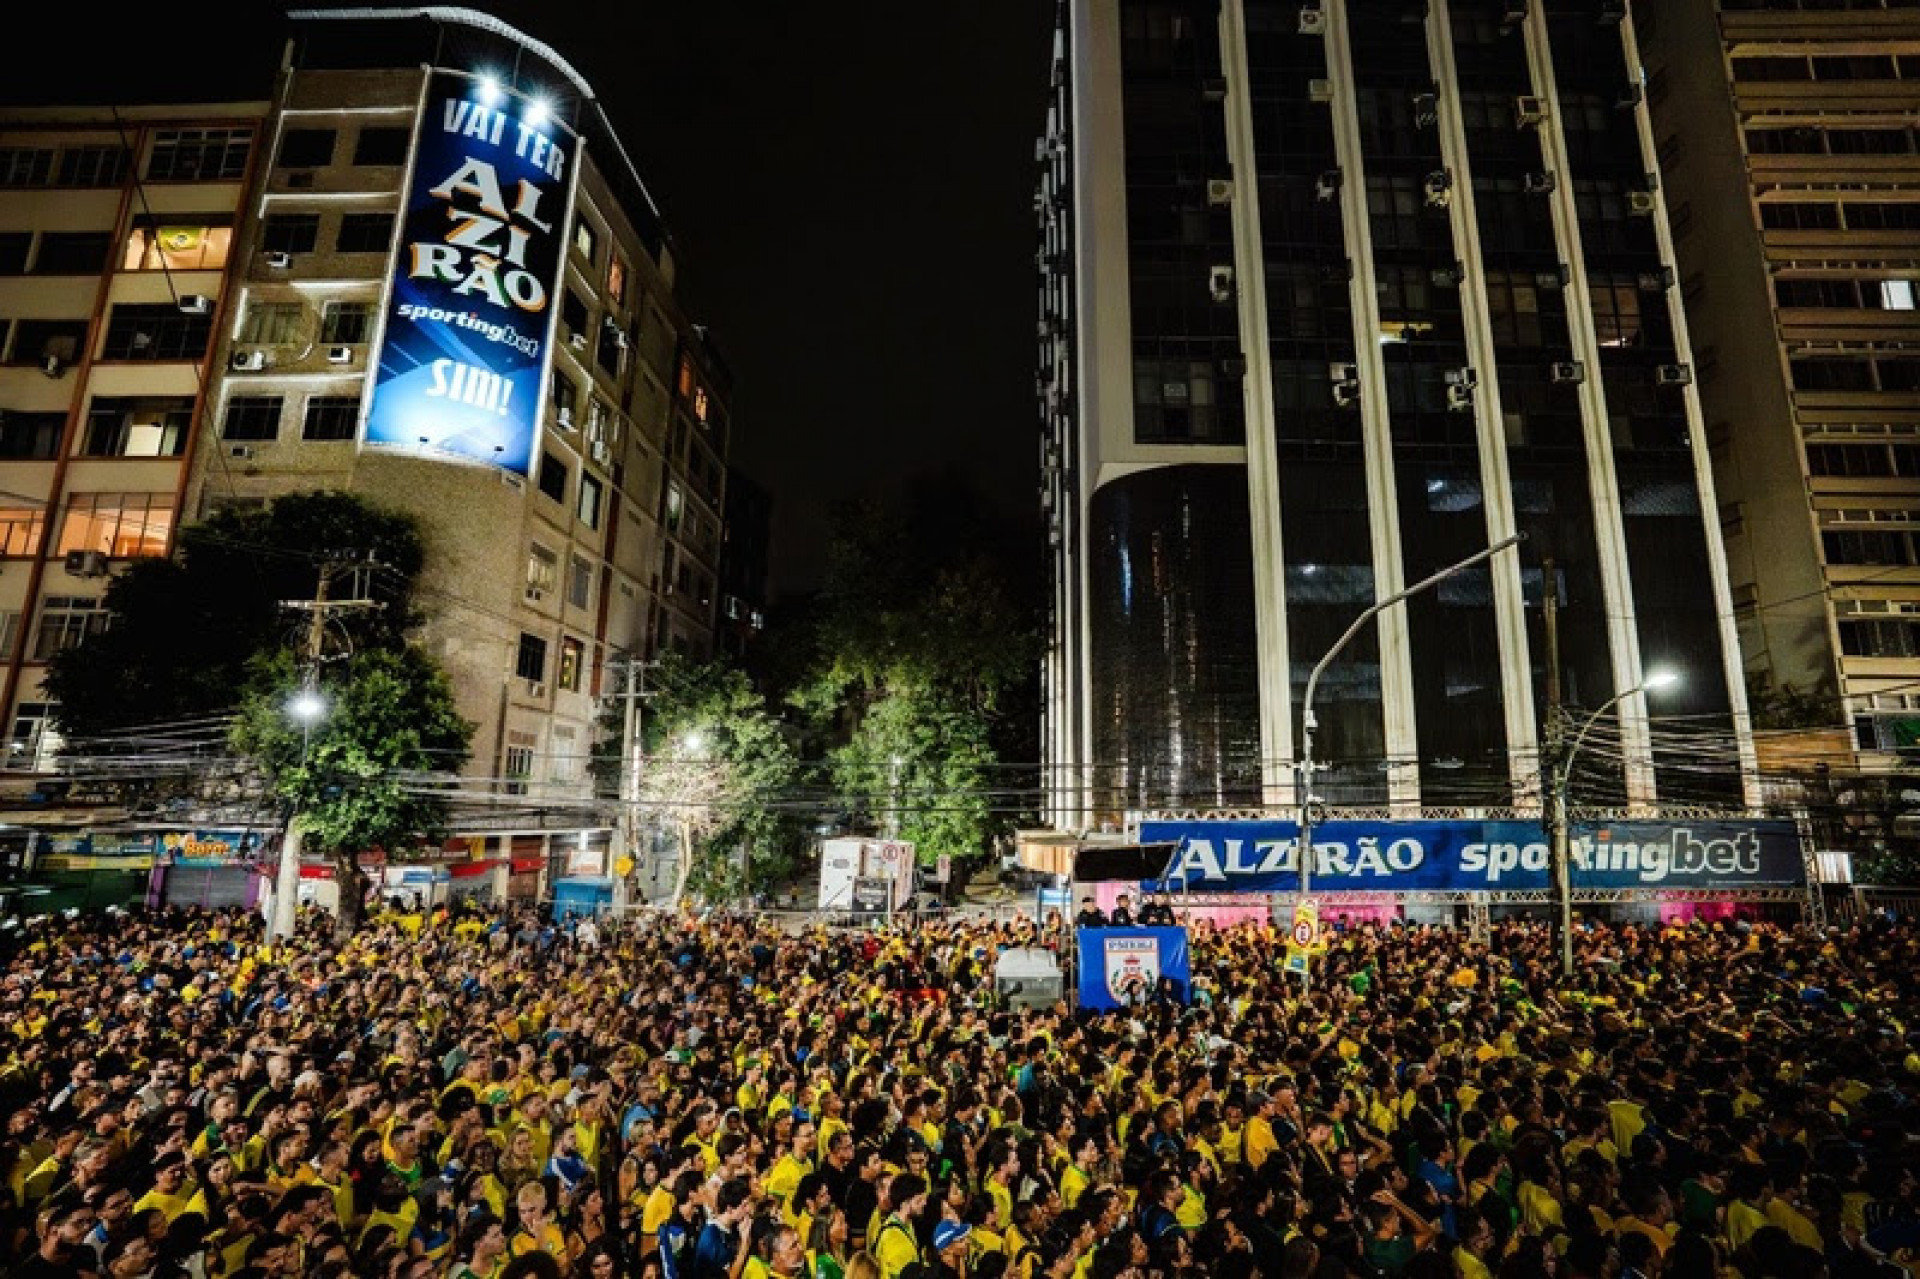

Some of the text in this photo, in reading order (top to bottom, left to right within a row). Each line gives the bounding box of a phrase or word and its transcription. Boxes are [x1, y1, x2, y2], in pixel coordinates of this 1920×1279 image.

[443, 98, 565, 182] VAI TER
[429, 156, 553, 234] AL
[408, 241, 547, 312] RÃO
[426, 357, 514, 416] SIM!
[1459, 828, 1760, 882] spotingbet
